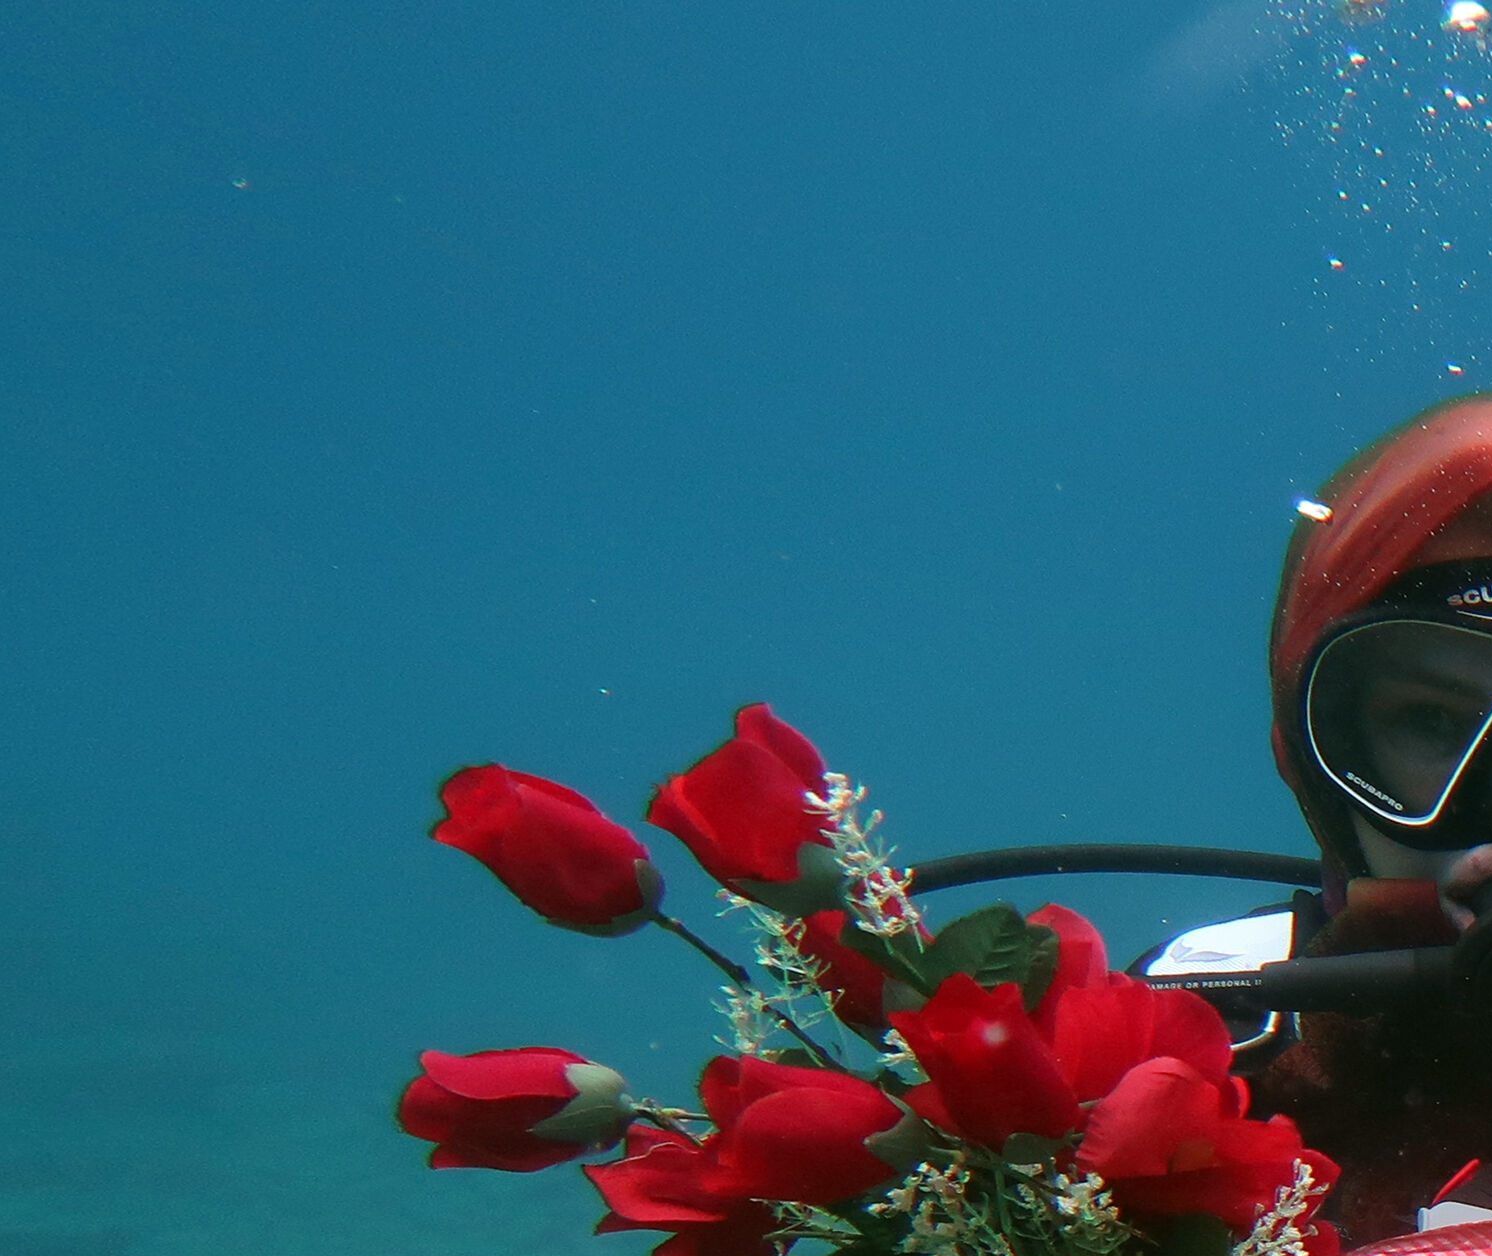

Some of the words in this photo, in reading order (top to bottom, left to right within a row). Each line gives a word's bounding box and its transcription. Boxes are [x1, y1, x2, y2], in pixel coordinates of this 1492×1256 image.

[1346, 771, 1404, 812] SCUBAPRO
[1185, 981, 1199, 989] OR
[1202, 979, 1251, 988] PERSONAL
